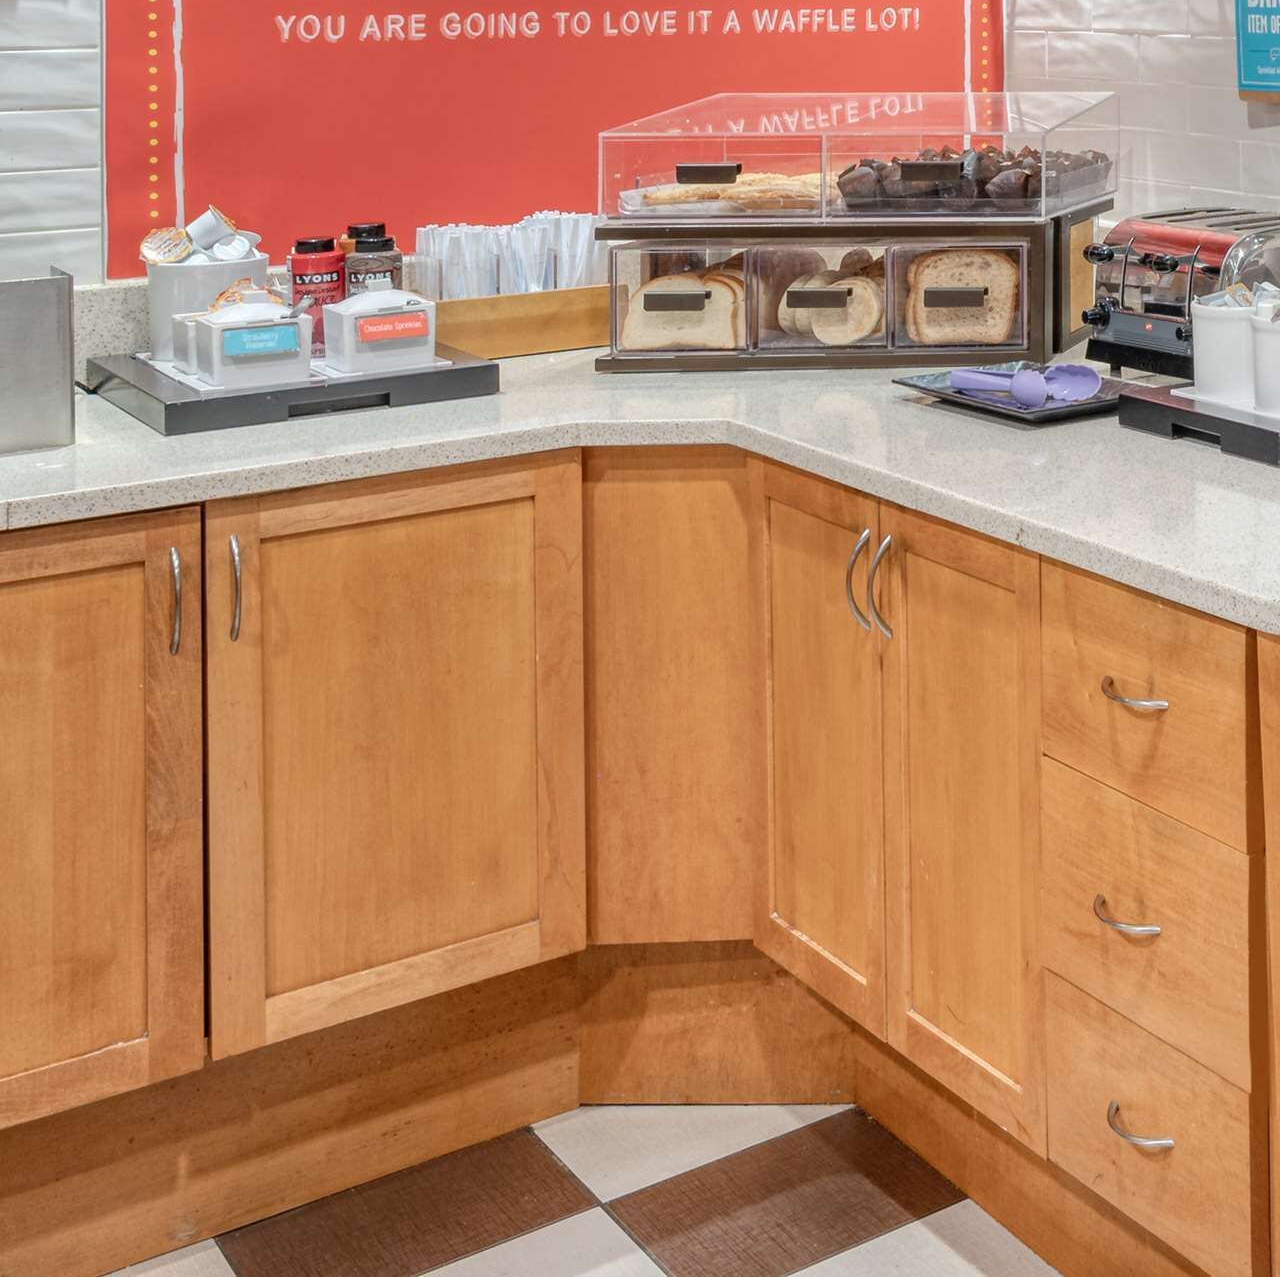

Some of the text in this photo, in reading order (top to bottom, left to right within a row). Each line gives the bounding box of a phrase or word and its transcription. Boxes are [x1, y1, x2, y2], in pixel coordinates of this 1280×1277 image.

[275, 6, 921, 43] YOU ARE GOING TO LOVE IT A WAFFLE LOT!
[1247, 14, 1268, 33] ITEM
[1270, 14, 1280, 34] OF
[296, 272, 338, 284] LYONS
[364, 323, 393, 333] Chocolate
